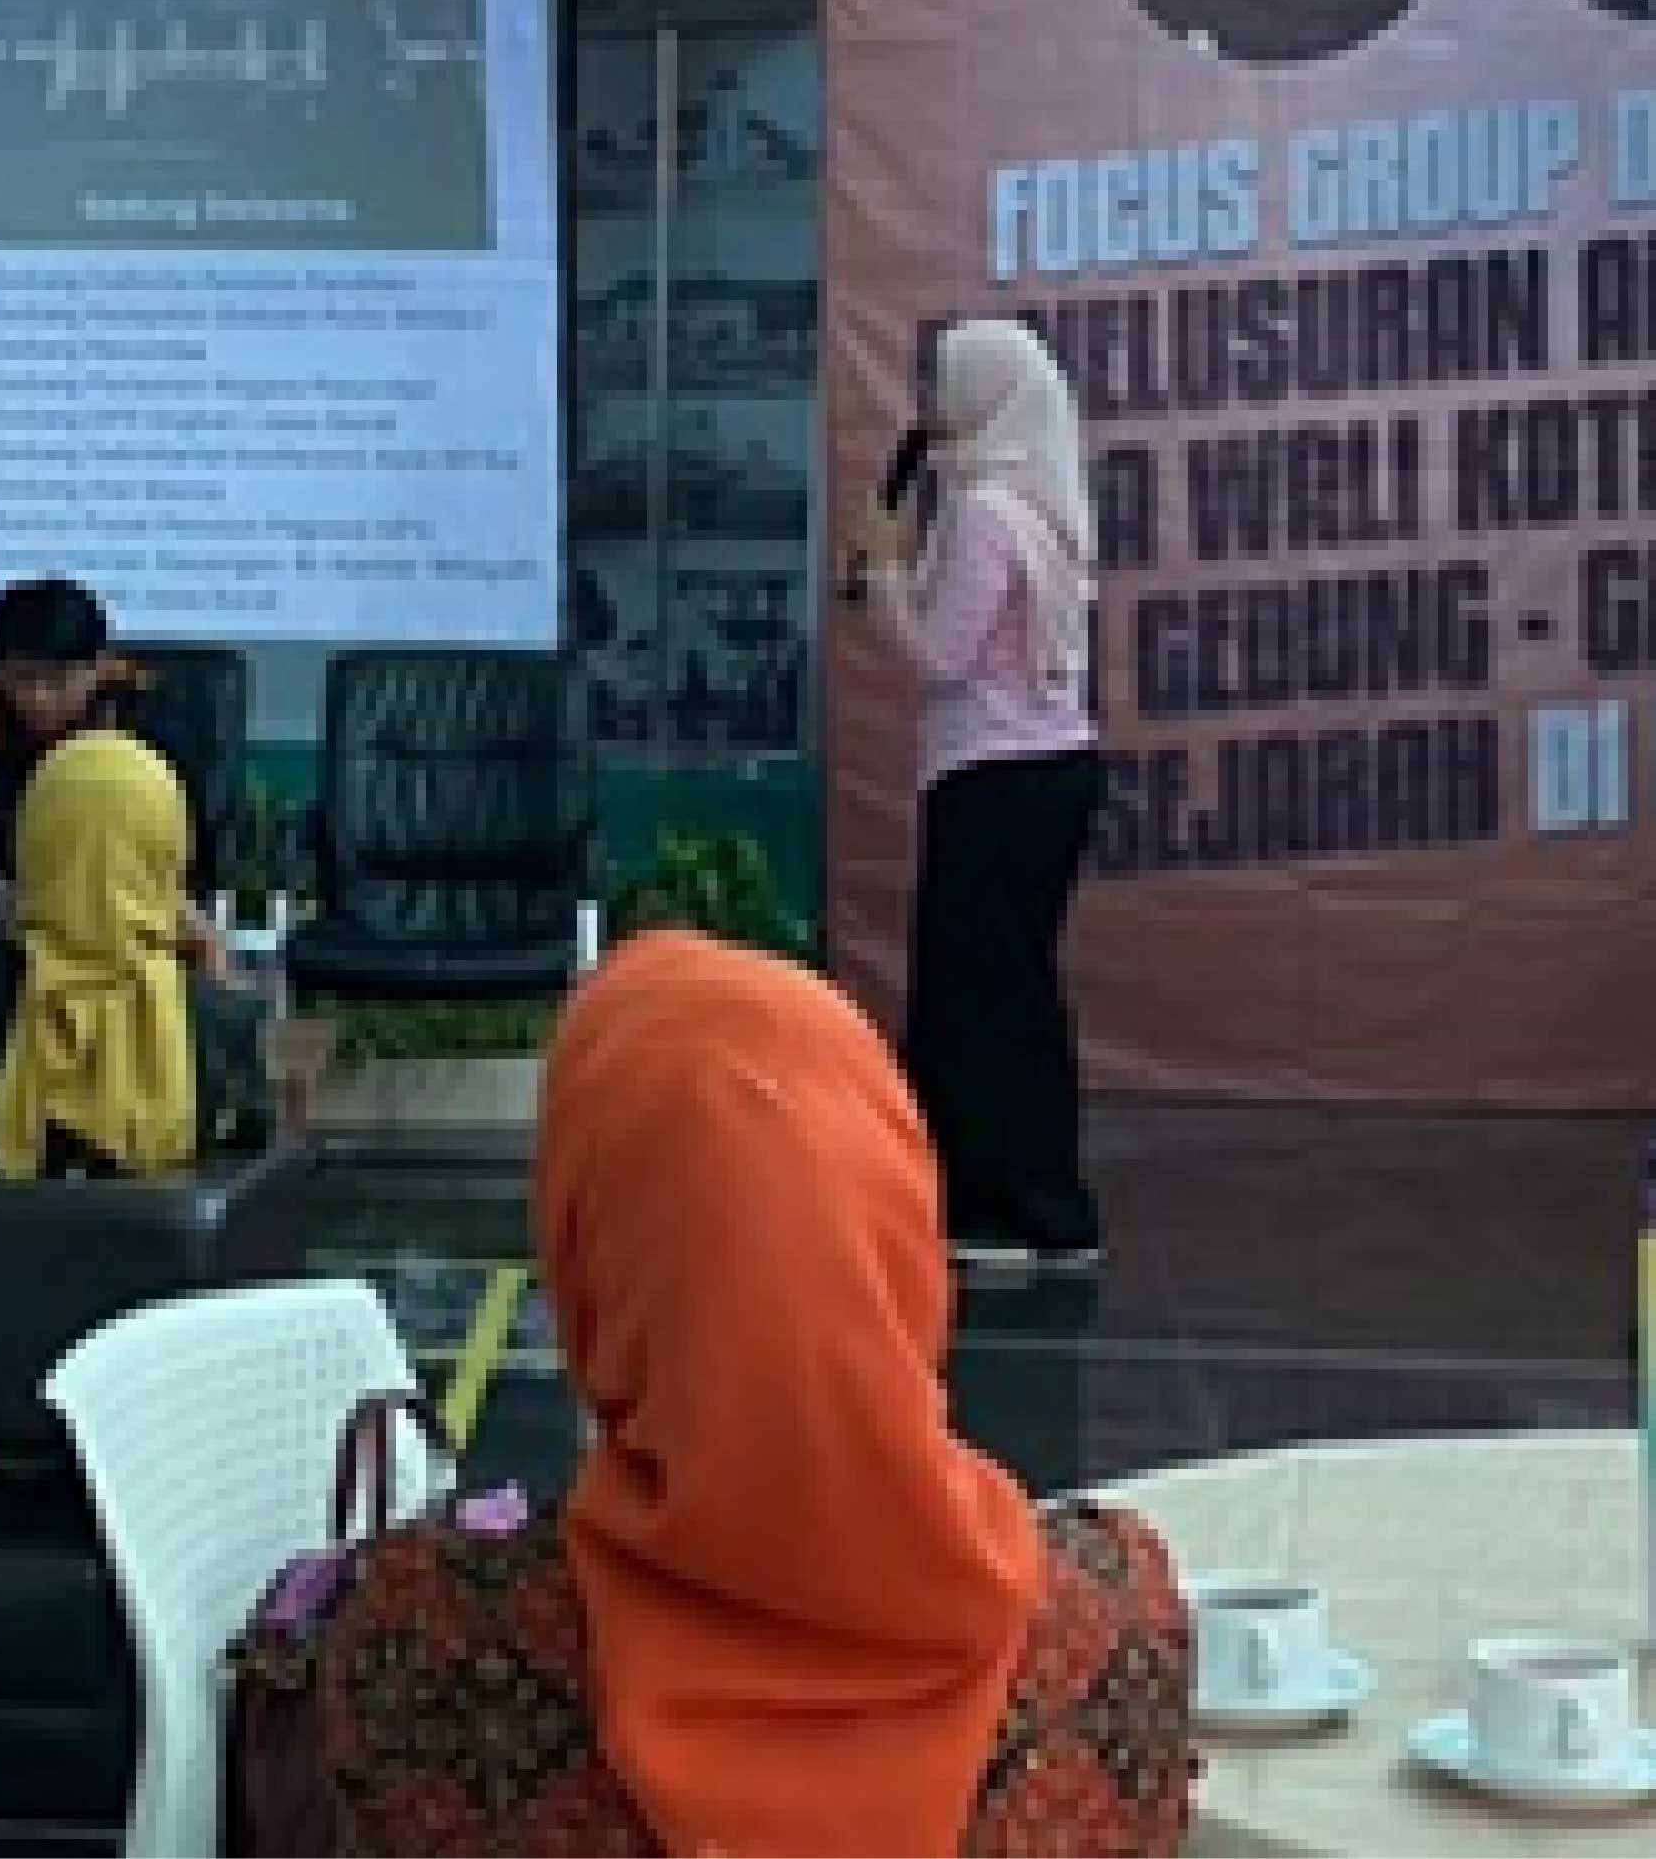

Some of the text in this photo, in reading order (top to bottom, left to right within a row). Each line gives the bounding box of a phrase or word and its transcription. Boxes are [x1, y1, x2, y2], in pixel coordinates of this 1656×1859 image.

[994, 140, 1257, 278] FOCUS
[1292, 106, 1576, 239] GROUP
[1190, 420, 1418, 560] WALI
[1139, 564, 1490, 715] GEDUNG
[1095, 719, 1498, 875] SEJARAH
[1535, 700, 1630, 832] DI
